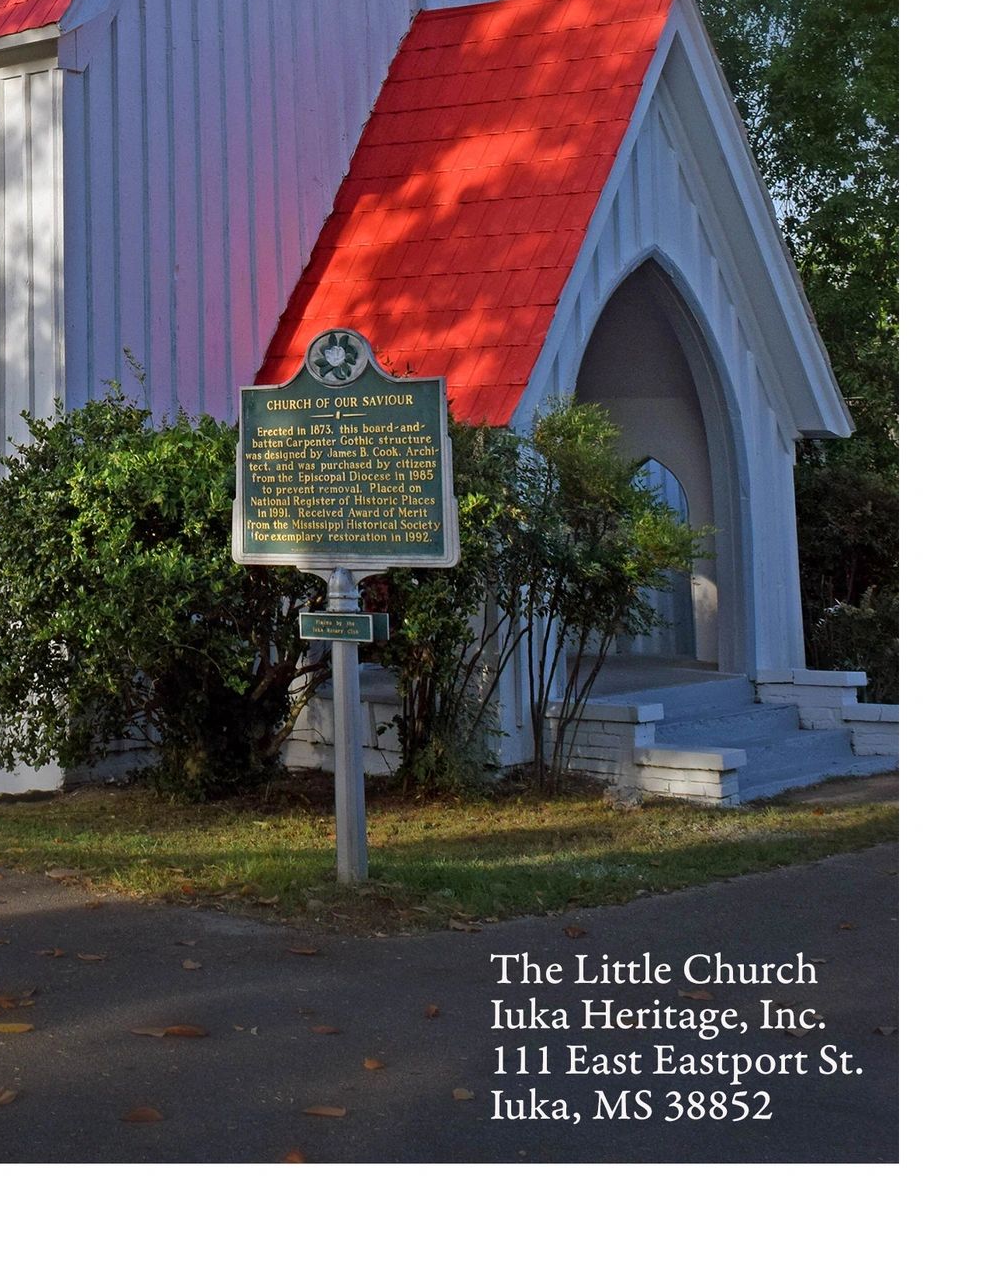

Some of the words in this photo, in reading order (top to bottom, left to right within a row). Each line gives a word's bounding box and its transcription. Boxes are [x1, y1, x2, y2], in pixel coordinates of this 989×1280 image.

[266, 398, 311, 410] CHURCH
[315, 398, 330, 409] OF
[334, 397, 358, 408] OUR
[362, 394, 413, 406] SAVIOUR
[257, 426, 293, 436] Erected
[297, 426, 306, 435] in
[339, 424, 358, 434] this
[252, 438, 283, 448] batten
[286, 437, 336, 449] Carpenter
[340, 435, 374, 445] Gothic
[378, 435, 432, 445] structure
[264, 450, 306, 461] designed
[310, 448, 323, 459] by
[327, 448, 357, 457] James
[360, 447, 369, 457] B.
[406, 445, 439, 456] Archi-
[276, 461, 294, 471] and
[298, 462, 315, 470] was
[320, 459, 372, 472] purchased
[376, 459, 390, 470] by
[396, 459, 436, 469] citizens
[252, 473, 275, 483] from
[278, 473, 293, 482] the
[298, 472, 346, 484] Episcopal
[349, 471, 391, 482] Diocese
[395, 471, 405, 481] in
[262, 485, 272, 494] to
[276, 485, 315, 496] prevent
[319, 484, 362, 494] removal.
[369, 482, 405, 493] Placed
[409, 485, 422, 493] on
[250, 496, 290, 506] National
[293, 496, 335, 508] Register
[338, 496, 350, 506] of
[354, 496, 398, 505] Historic
[401, 495, 436, 505] Places
[258, 508, 267, 518] in
[269, 507, 291, 518] 1991.
[298, 508, 343, 518] Received
[348, 508, 379, 518] Award
[383, 507, 394, 517] of
[398, 507, 427, 517] Merit
[247, 520, 270, 529] from
[273, 520, 288, 529] the
[291, 520, 344, 532] Mississippi
[346, 519, 397, 530] Historical
[400, 520, 440, 531] Society
[254, 531, 269, 541] for
[270, 532, 323, 543] exemplary
[328, 532, 387, 541] restoration
[391, 532, 401, 542] in
[405, 531, 432, 542] 1992.
